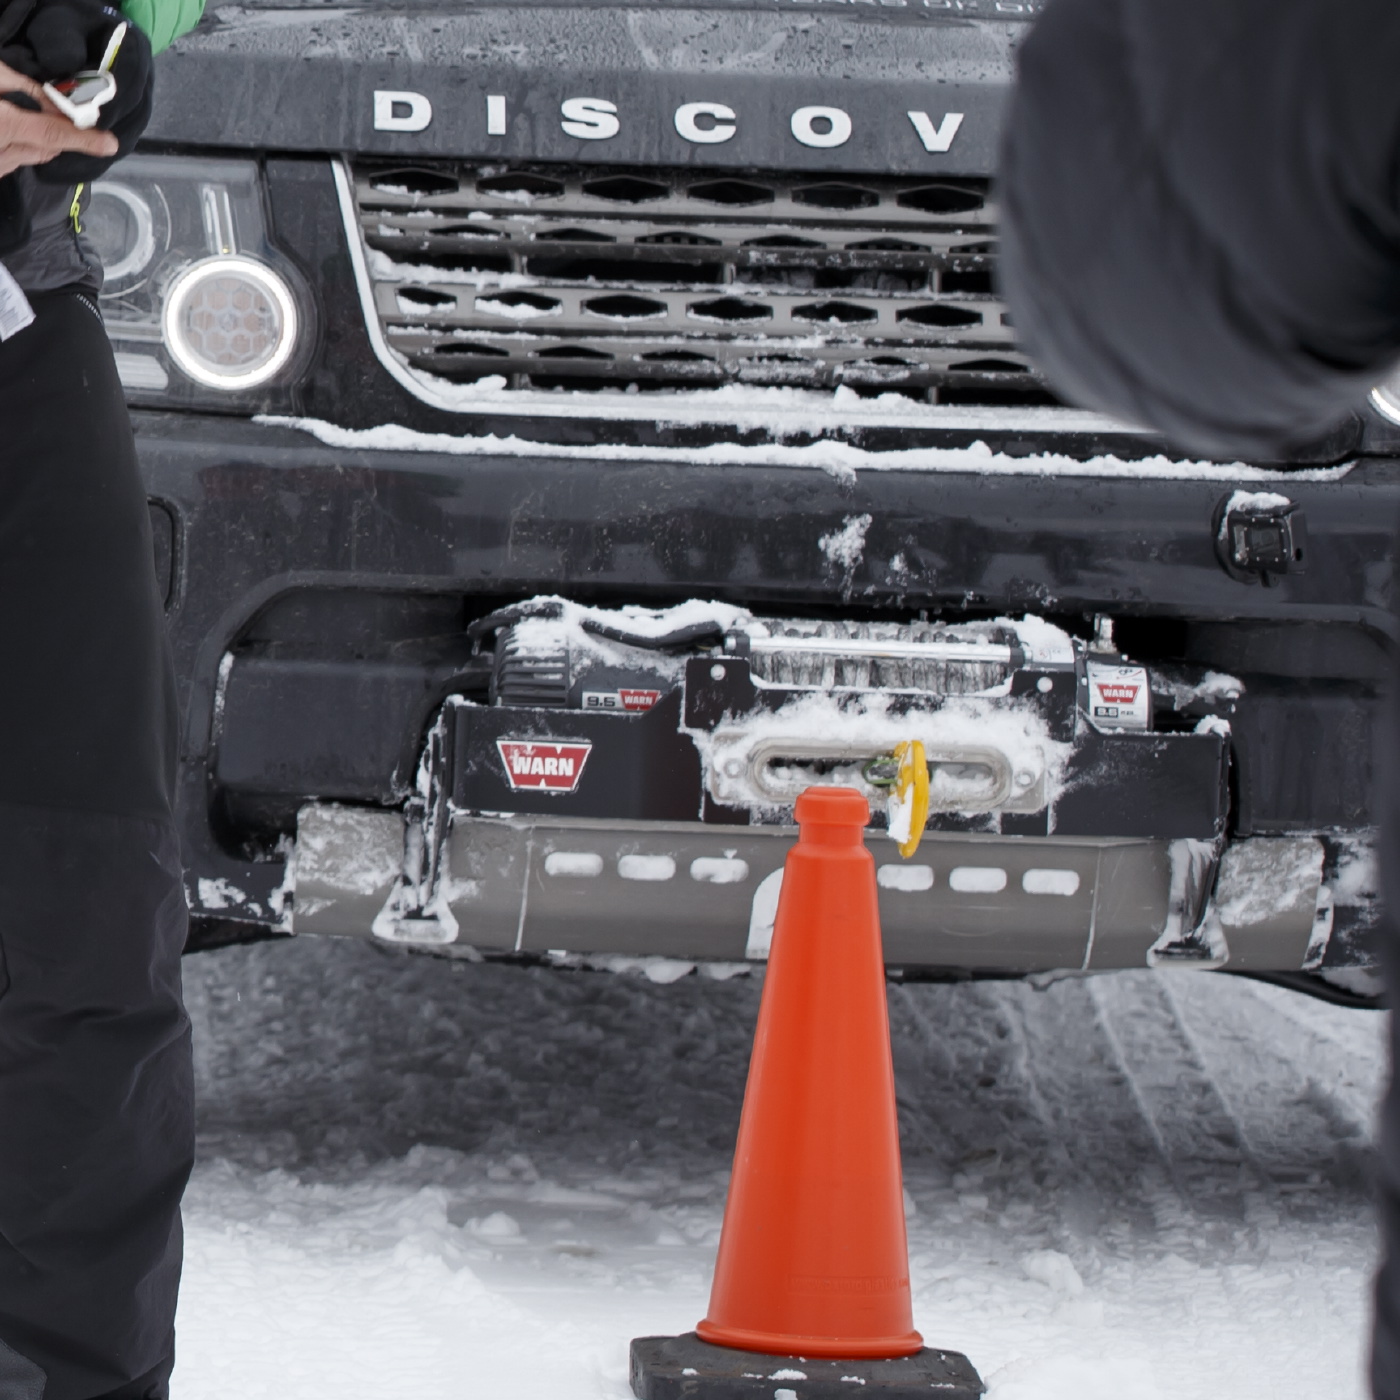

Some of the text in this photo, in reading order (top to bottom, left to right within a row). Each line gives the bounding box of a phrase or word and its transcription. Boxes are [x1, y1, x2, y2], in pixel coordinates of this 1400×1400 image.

[374, 90, 964, 153] DISCOV
[624, 695, 653, 705] WARN
[1104, 688, 1133, 699] WARN
[513, 756, 574, 776] WARN
